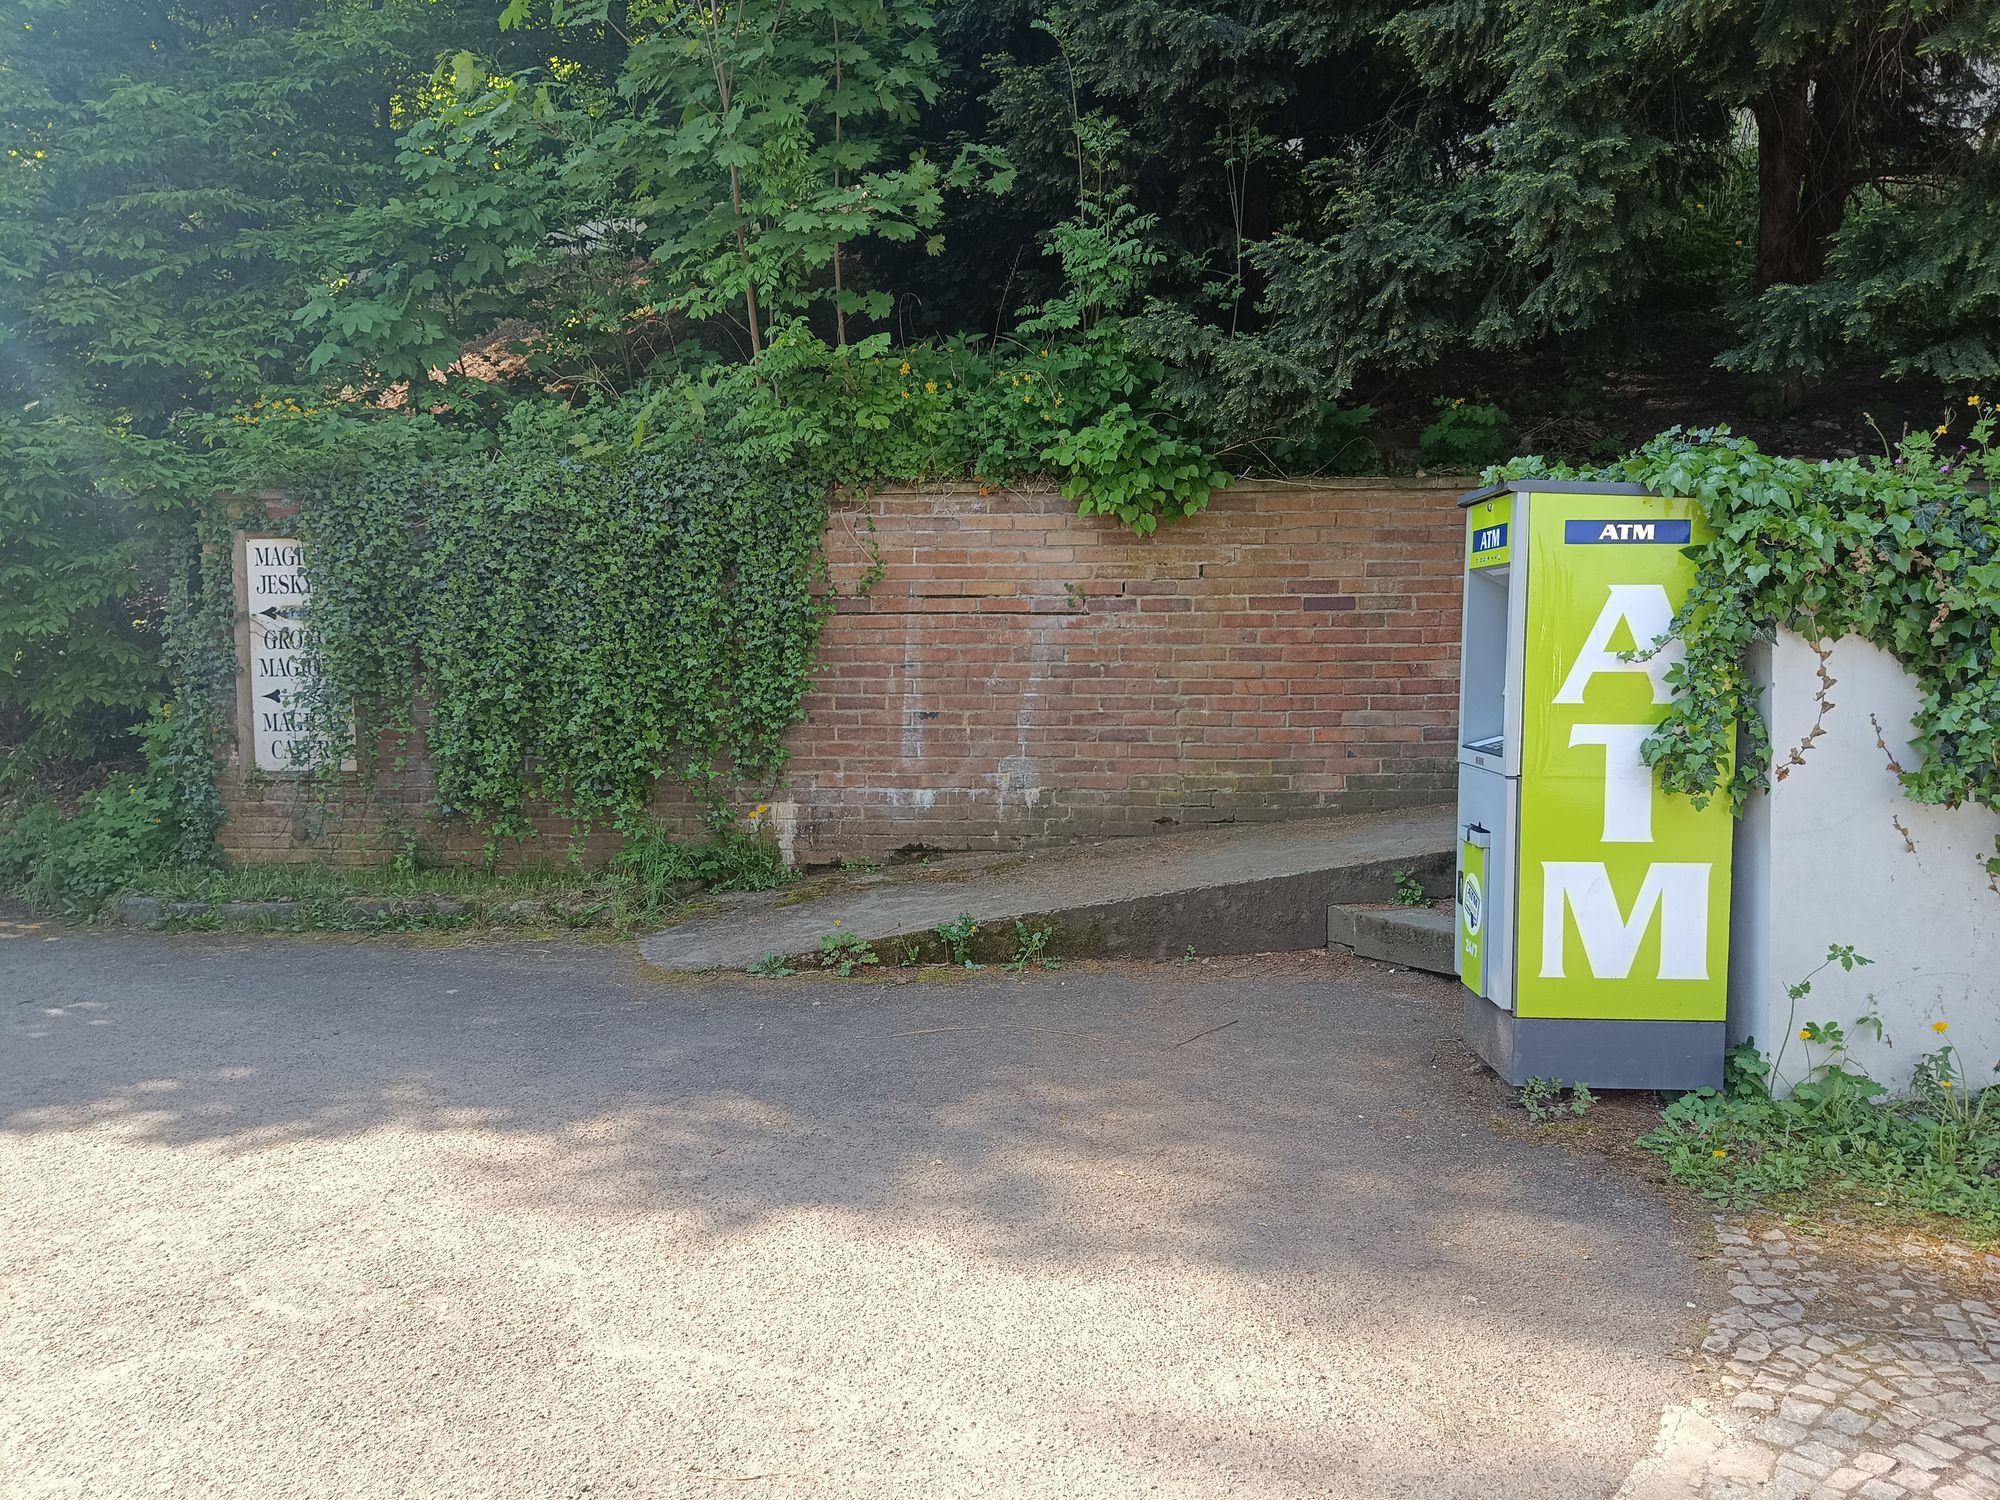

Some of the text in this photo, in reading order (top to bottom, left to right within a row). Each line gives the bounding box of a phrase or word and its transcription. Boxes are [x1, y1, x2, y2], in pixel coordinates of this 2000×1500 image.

[1479, 527, 1500, 551] ATM
[1598, 523, 1656, 541] ATM
[254, 546, 304, 567] MAGI
